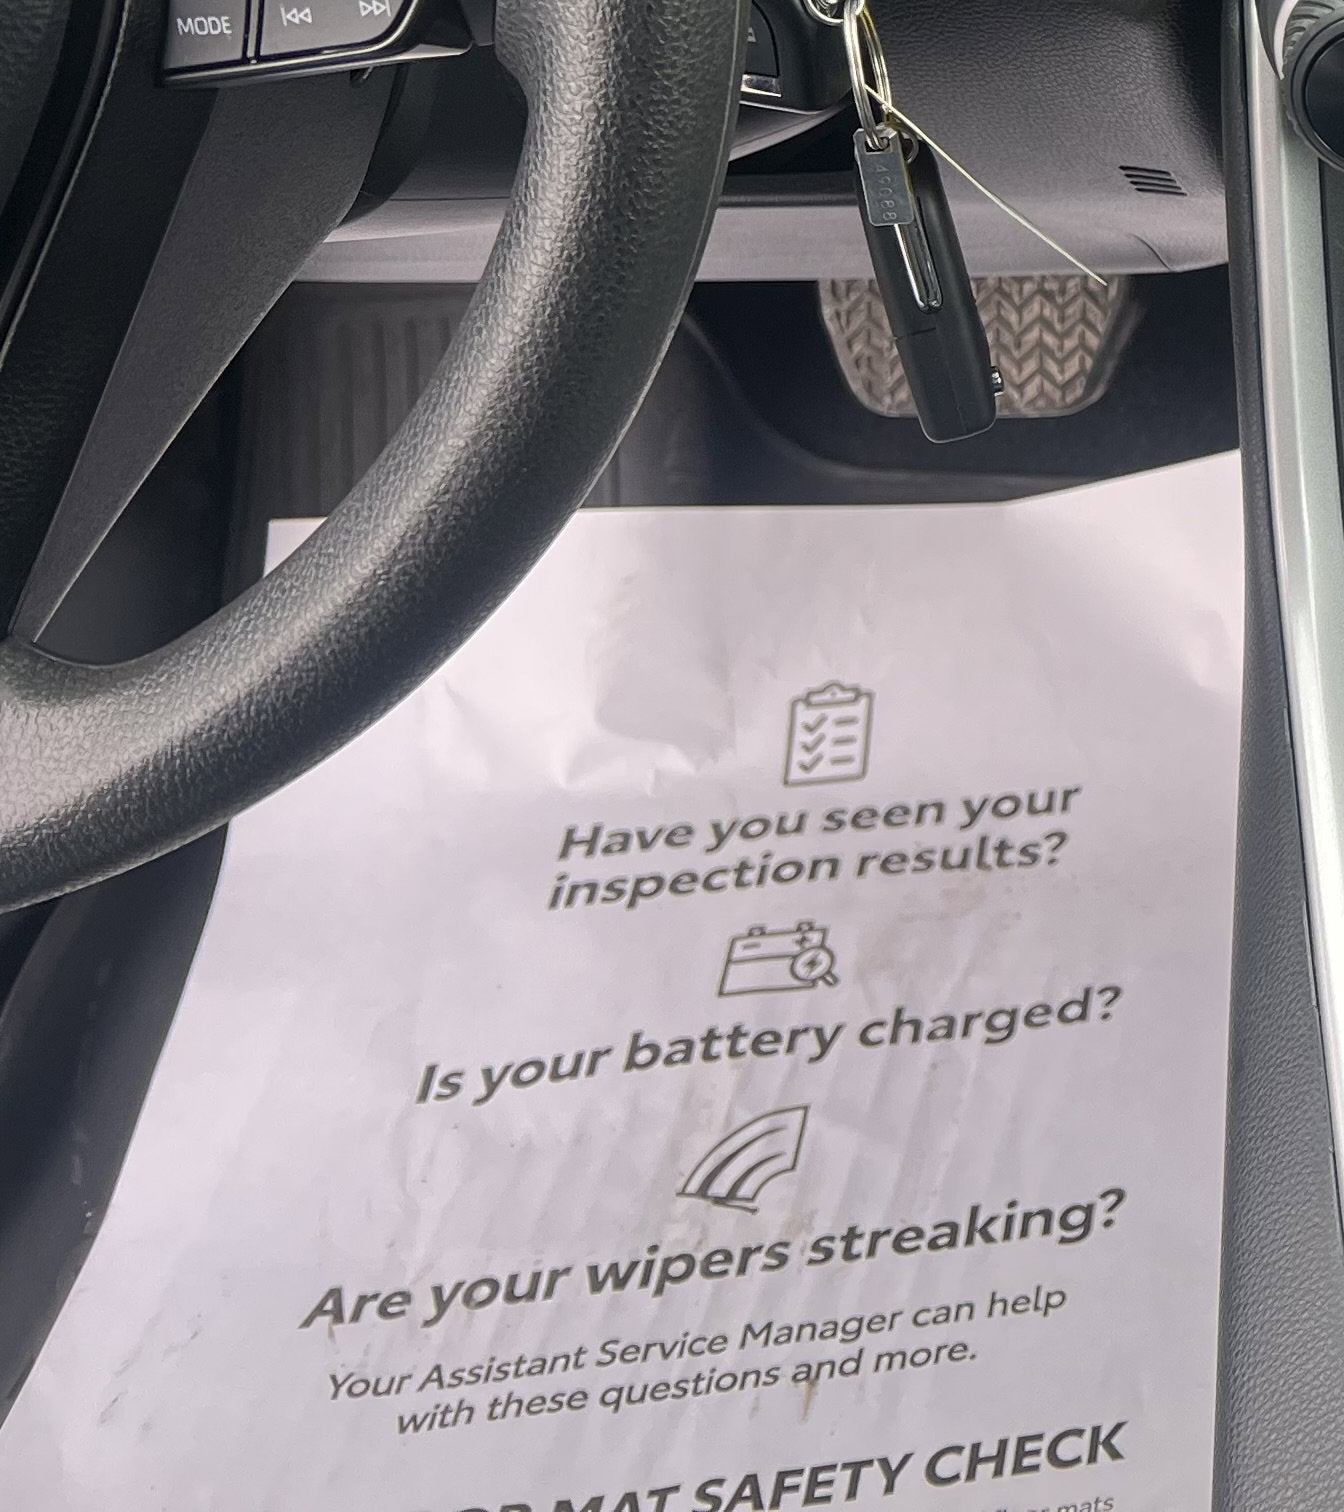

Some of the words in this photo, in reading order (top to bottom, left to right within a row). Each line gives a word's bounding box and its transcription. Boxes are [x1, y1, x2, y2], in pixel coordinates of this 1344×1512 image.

[177, 16, 232, 35] MODE
[558, 823, 694, 860] Have
[705, 812, 807, 853] you
[822, 800, 946, 832] seen
[960, 787, 1081, 830] your
[549, 852, 839, 911] inspection
[857, 831, 1068, 877] results?
[416, 1064, 464, 1104] Is
[473, 1048, 613, 1106] your
[623, 1024, 845, 1072] battery
[859, 985, 1122, 1047] charged?
[299, 1286, 412, 1328] Are
[422, 1267, 573, 1328] your
[587, 1241, 791, 1297] wipers
[806, 1188, 1126, 1265] streaking?
[330, 1372, 413, 1400] Your
[417, 1346, 588, 1392] Assistant
[595, 1331, 728, 1374] Service
[739, 1311, 903, 1349] Manager
[912, 1302, 975, 1327] can
[987, 1285, 1067, 1318] help
[398, 1398, 474, 1434] with
[487, 1390, 589, 1421] these
[599, 1367, 781, 1414] questions
[792, 1348, 864, 1382] and
[873, 1343, 976, 1372] more.
[692, 1453, 914, 1512] SAFETY
[925, 1421, 1128, 1486] CHECK
